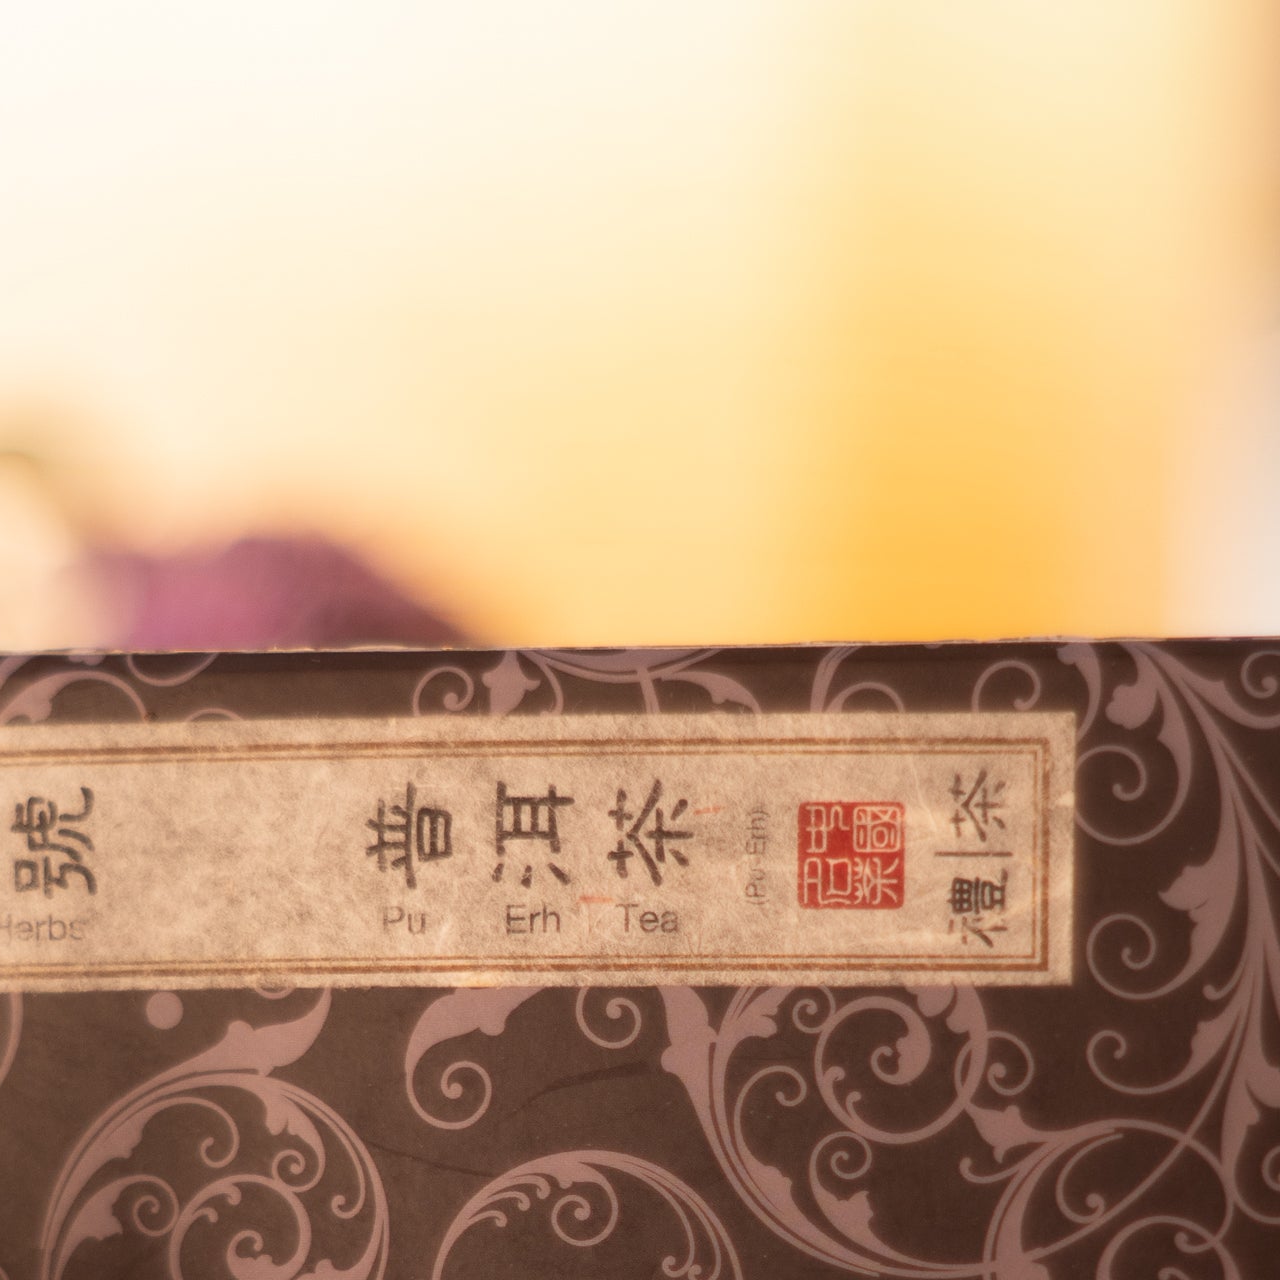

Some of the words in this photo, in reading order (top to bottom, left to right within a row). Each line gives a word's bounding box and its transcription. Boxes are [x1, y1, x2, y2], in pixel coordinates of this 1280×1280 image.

[365, 780, 695, 889] 普洱茶
[381, 905, 427, 935] Pu
[506, 904, 561, 935] Erh
[619, 903, 681, 935] Tea
